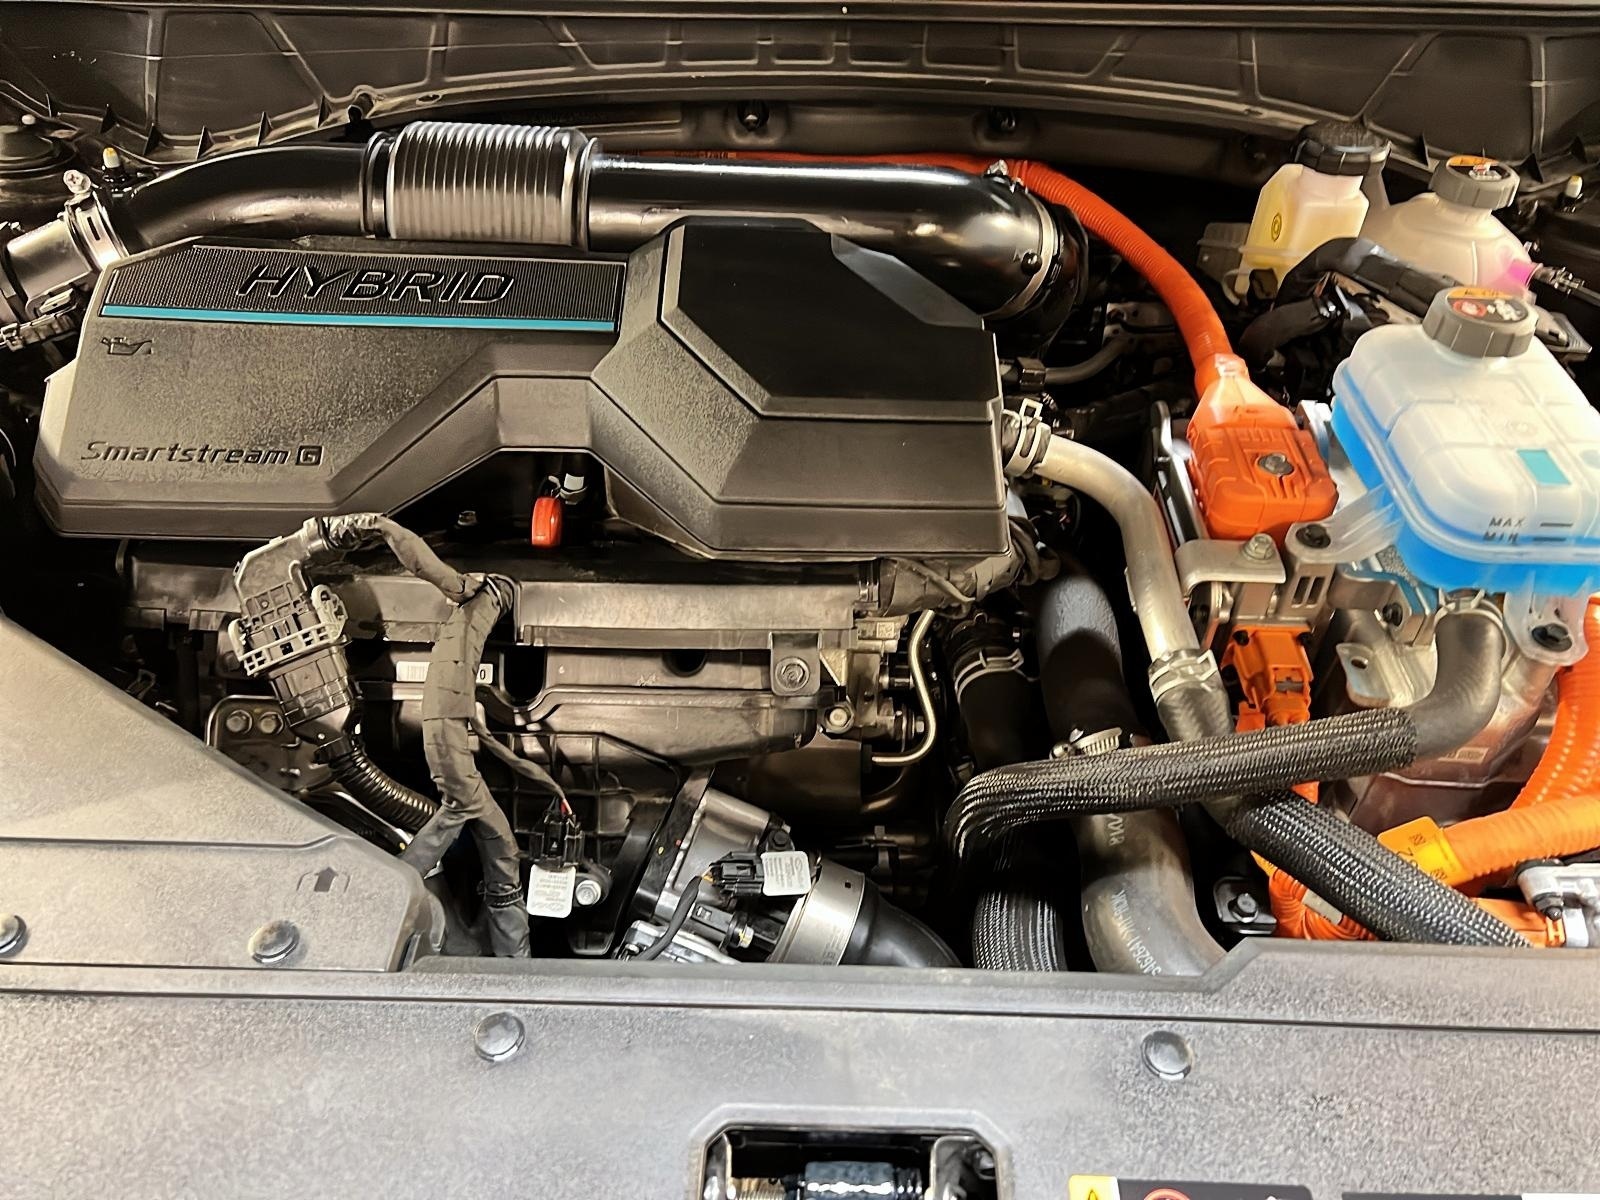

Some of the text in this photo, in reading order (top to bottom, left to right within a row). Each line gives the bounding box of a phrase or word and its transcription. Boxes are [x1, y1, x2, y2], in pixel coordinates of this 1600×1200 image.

[236, 265, 515, 303] HYBRID
[80, 440, 291, 465] Smartstream
[1489, 516, 1526, 528] MAX
